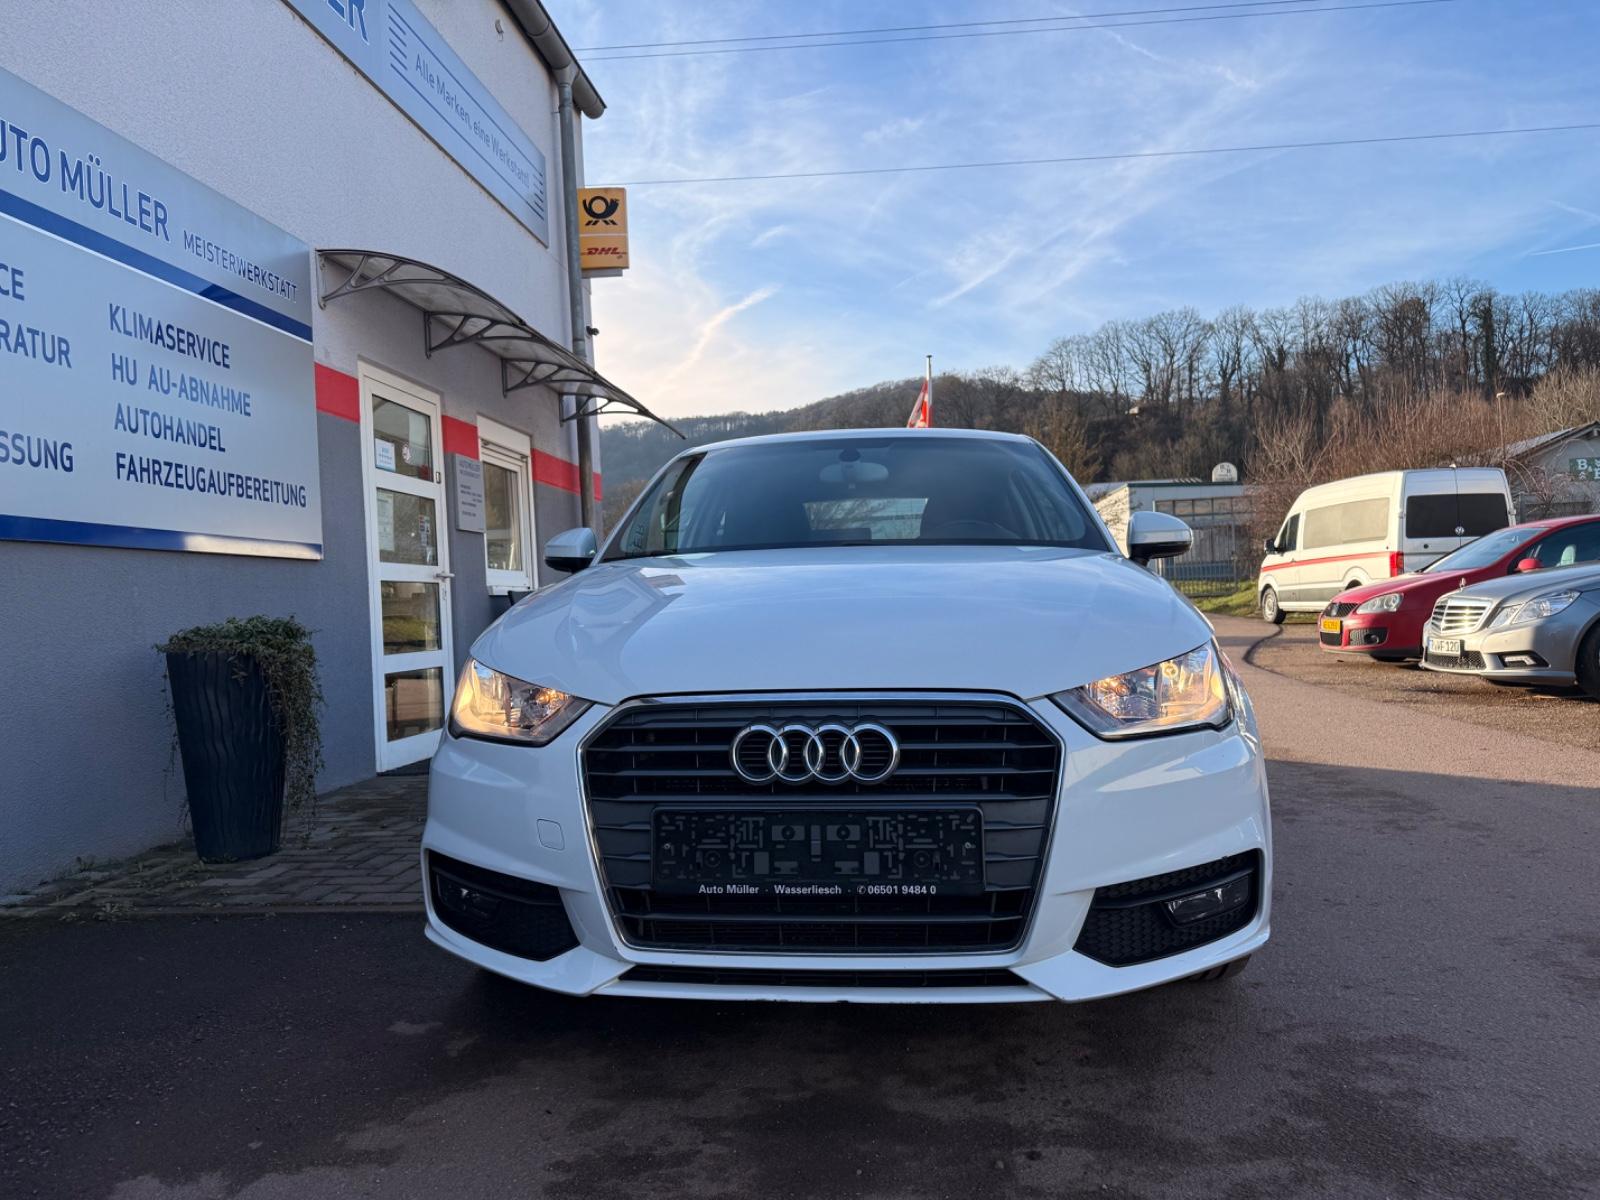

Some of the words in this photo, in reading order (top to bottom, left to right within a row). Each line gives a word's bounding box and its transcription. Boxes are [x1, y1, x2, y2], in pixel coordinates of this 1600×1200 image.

[416, 53, 435, 89] Alle
[473, 121, 491, 148] eine
[60, 150, 170, 242] MÜLLER
[184, 229, 297, 300] MEISTERWERKSTATT
[586, 247, 621, 256] DHL
[0, 319, 72, 369] RATUR
[109, 303, 230, 369] KLIMASERVICE
[112, 353, 138, 386] HU
[148, 364, 252, 417] AU-ABNAHME
[114, 402, 227, 453] AUTOHANDEL
[116, 452, 307, 508] FAHRZEUGAUFBEREITUNG
[698, 884, 724, 895] Auto
[726, 884, 760, 895] Müller
[774, 884, 842, 895] Wasserliesch
[867, 885, 898, 895] 06501
[901, 885, 928, 895] 9484
[929, 885, 937, 895] 0
